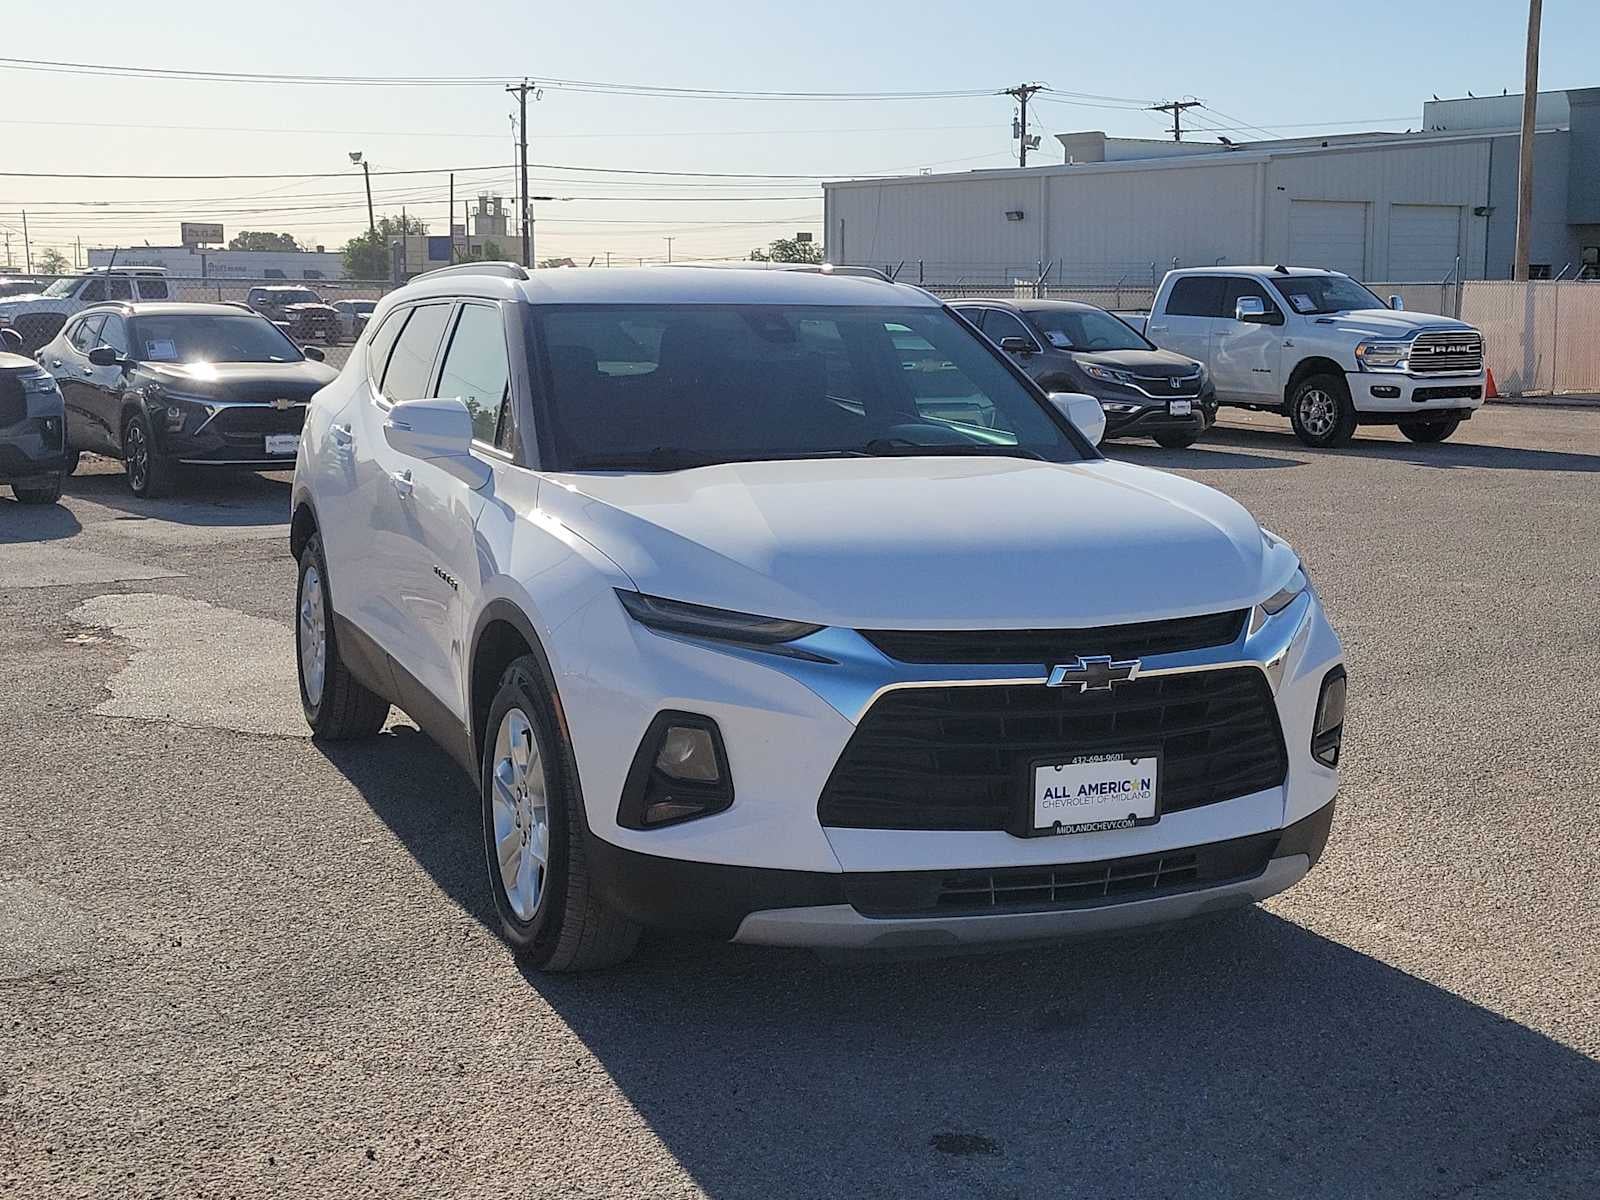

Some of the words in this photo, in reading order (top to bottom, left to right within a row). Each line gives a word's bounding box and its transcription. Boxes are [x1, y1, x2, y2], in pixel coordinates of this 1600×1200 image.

[1435, 345, 1466, 353] RAM
[1042, 796, 1095, 809] CHEVROLET
[1097, 794, 1108, 804] OF
[1111, 790, 1151, 801] MIDLAND
[1043, 786, 1071, 800] ALL
[1056, 819, 1136, 835] MIDLANDCHEVY.COM
